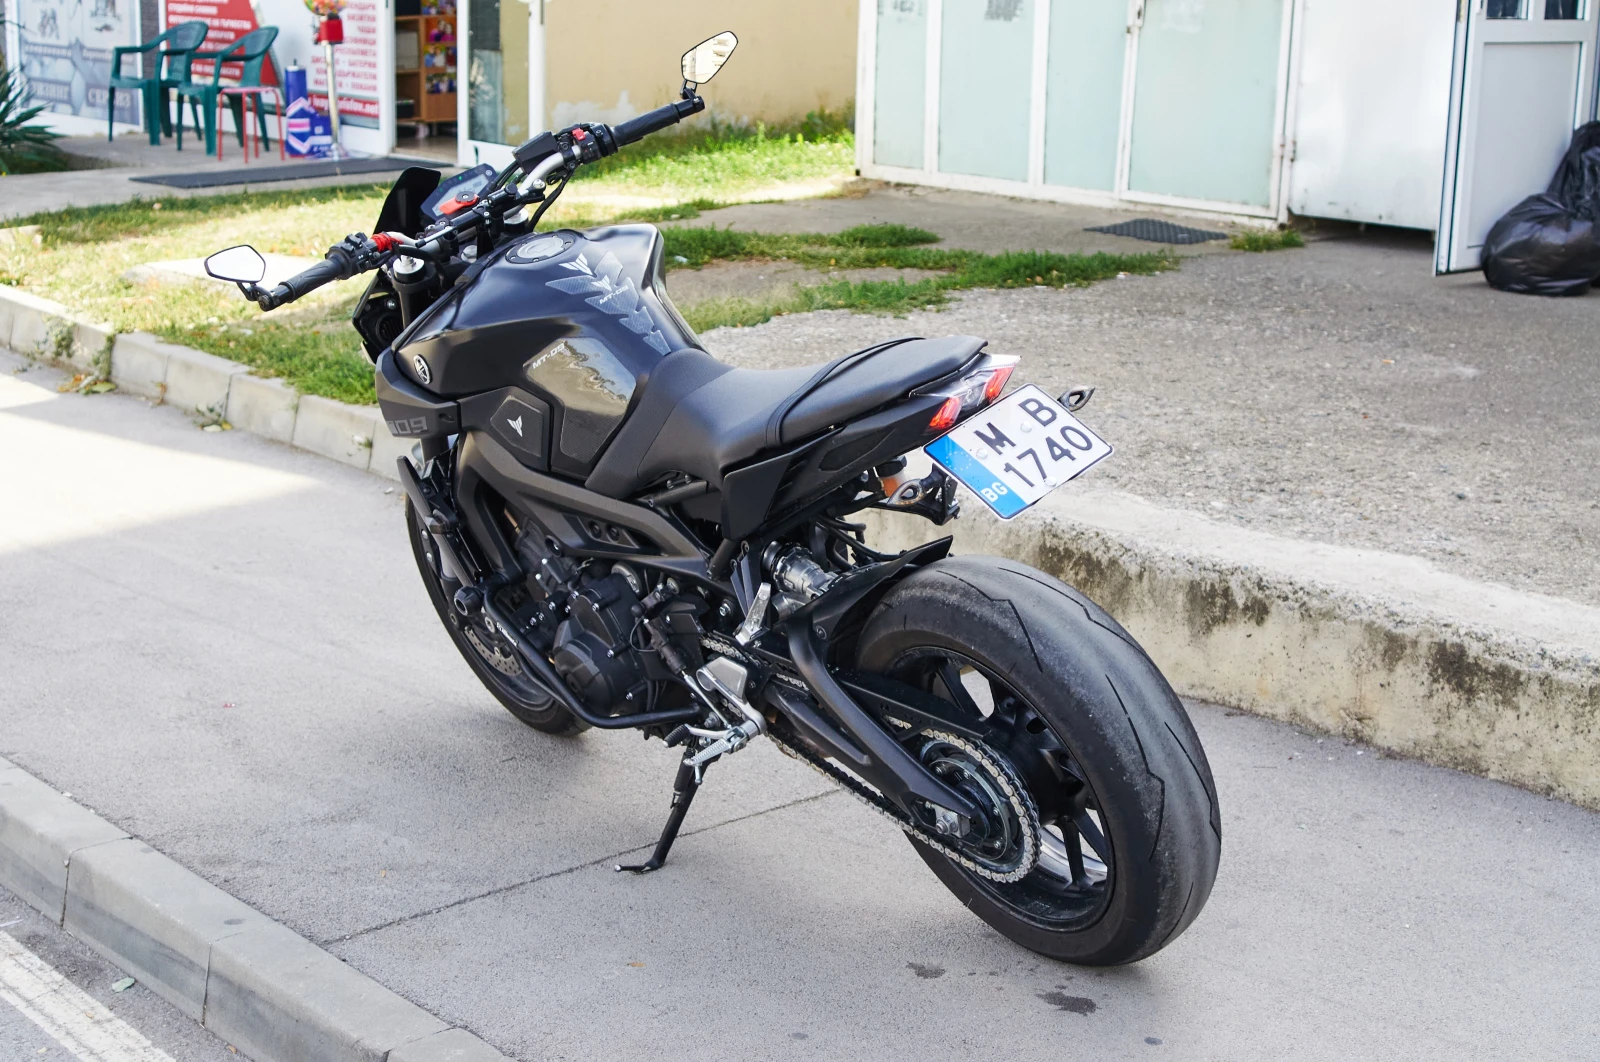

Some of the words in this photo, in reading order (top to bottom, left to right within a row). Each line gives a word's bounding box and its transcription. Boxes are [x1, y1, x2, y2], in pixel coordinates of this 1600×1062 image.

[88, 87, 132, 107] СЕРИЗ
[600, 285, 629, 305] MT-09
[532, 341, 566, 370] MT-09
[973, 422, 1017, 455] M
[1018, 398, 1058, 427] B
[1003, 425, 1093, 488] 1740
[980, 482, 1008, 502] BG
